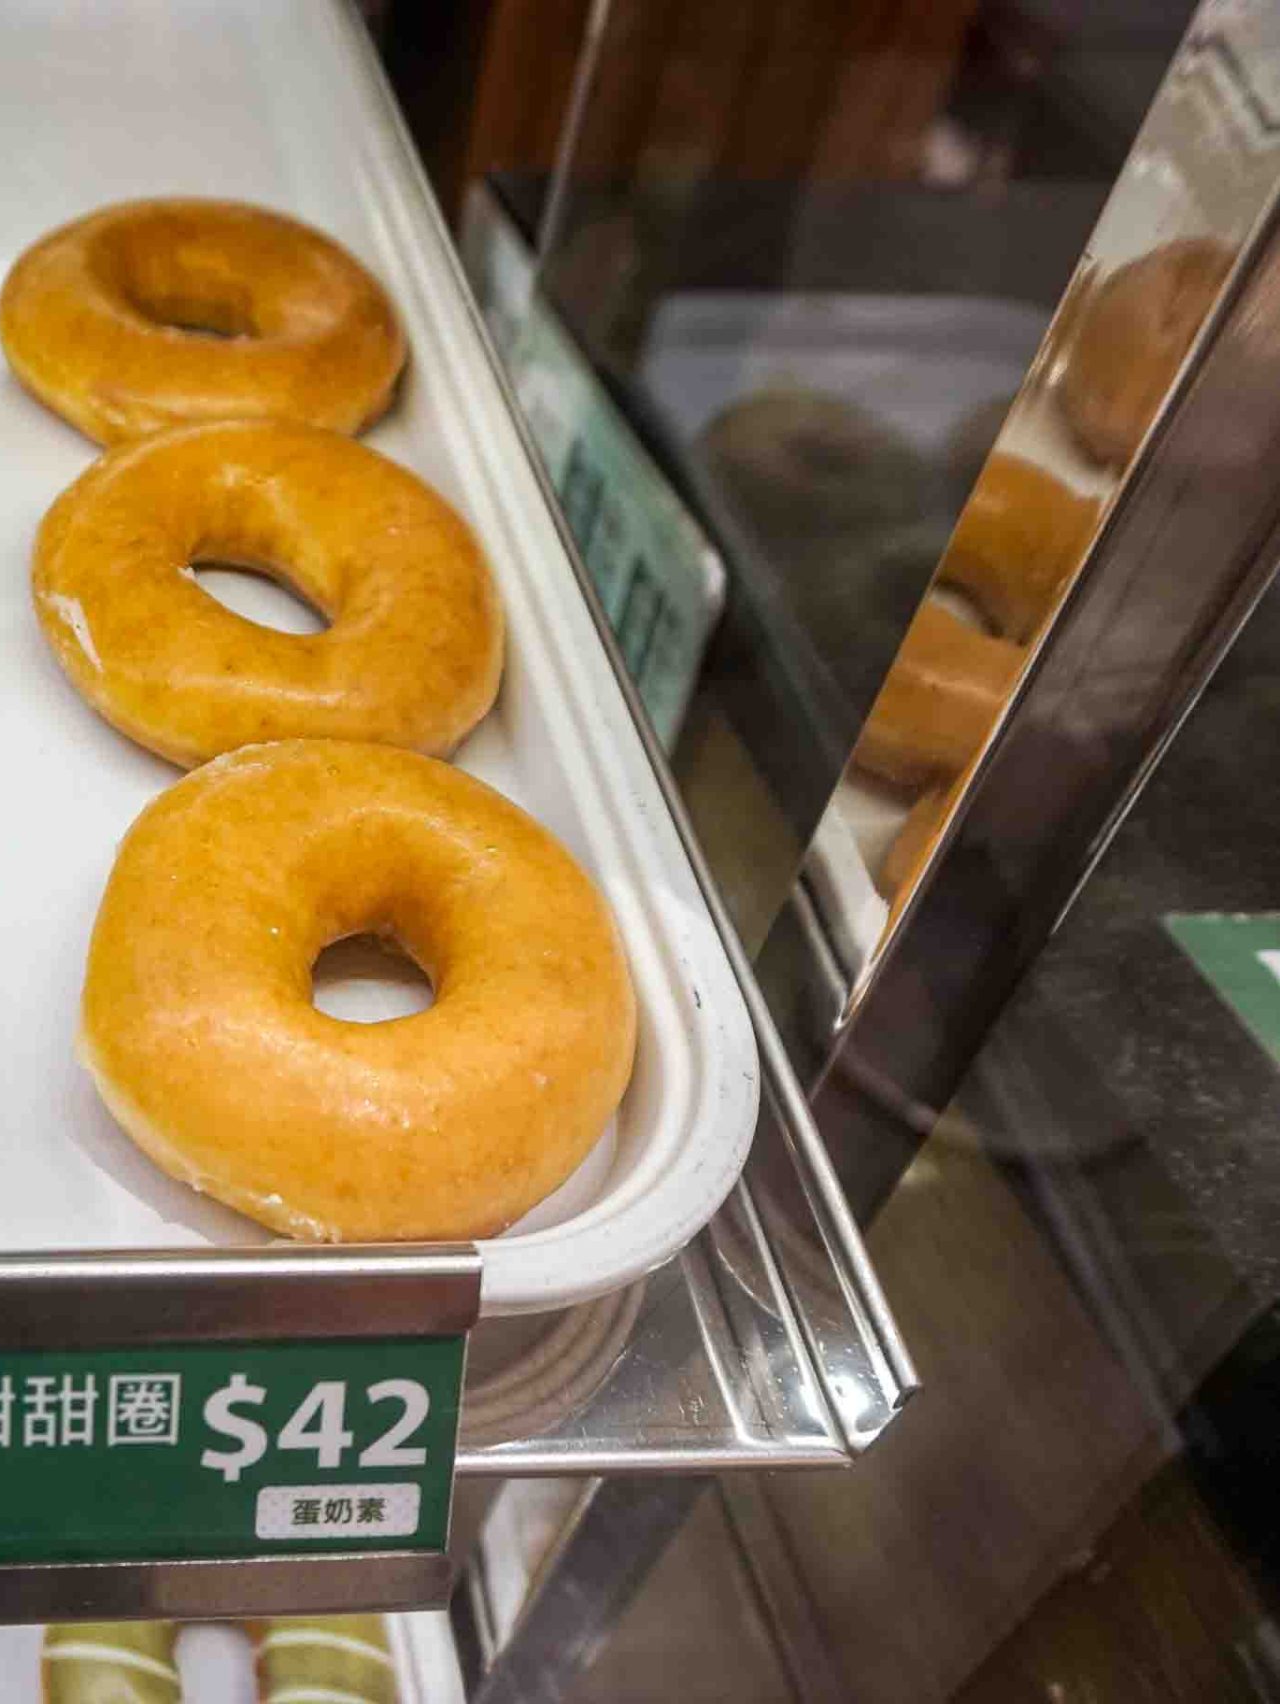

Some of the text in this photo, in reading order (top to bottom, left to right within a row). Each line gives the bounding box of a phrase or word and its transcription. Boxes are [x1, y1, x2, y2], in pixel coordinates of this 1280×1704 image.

[201, 1373, 431, 1482] $42
[291, 1496, 386, 1526] 蛋奶素
